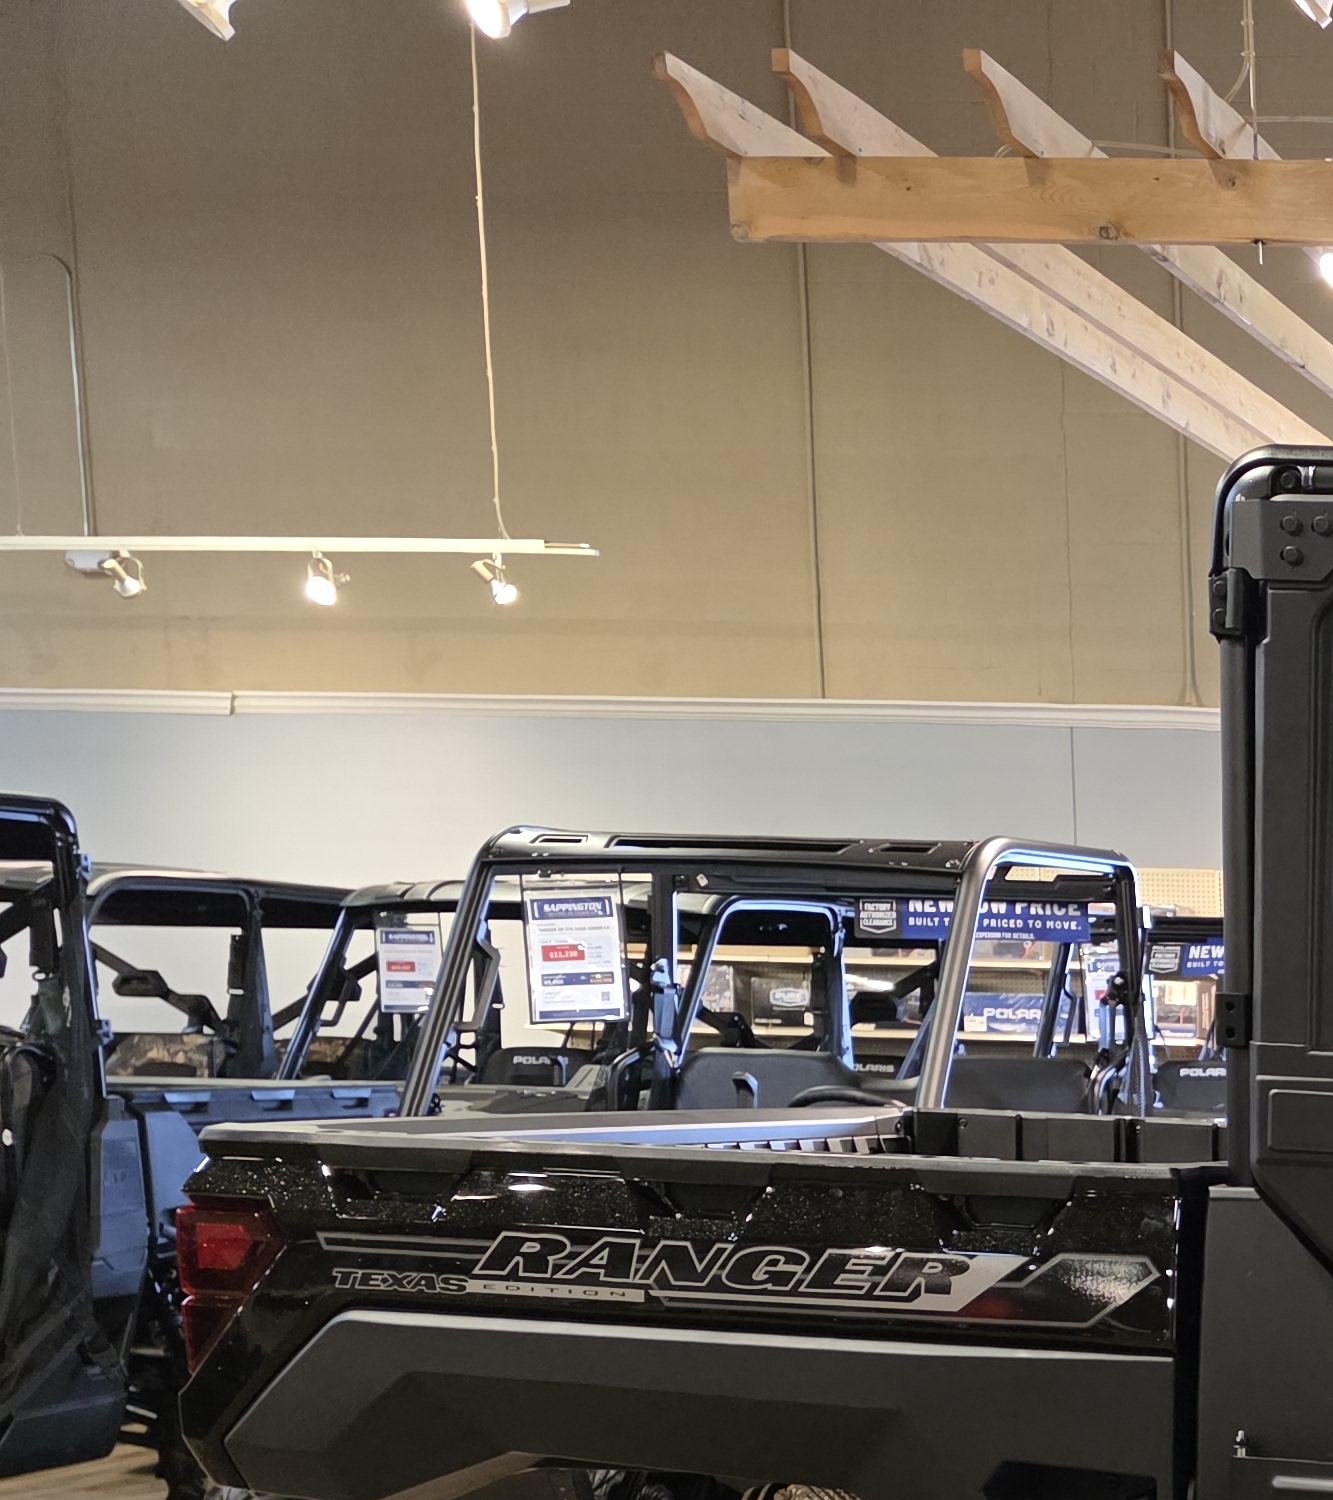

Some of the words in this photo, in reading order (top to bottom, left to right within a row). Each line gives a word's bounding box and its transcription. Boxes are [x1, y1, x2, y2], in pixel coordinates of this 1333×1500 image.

[908, 900, 954, 913] NEW
[979, 901, 1007, 914] OW
[908, 917, 940, 926] BUILT
[983, 918, 1024, 928] PRICED
[1026, 919, 1042, 929] TO
[1046, 920, 1082, 930] MOVE.
[1188, 945, 1224, 959] NEW
[983, 1007, 1042, 1021] POLAR
[853, 1063, 894, 1073] OLARIS
[472, 1230, 971, 1296] RANGER
[332, 1267, 469, 1294] TEXAS
[482, 1283, 627, 1298] EDITION
